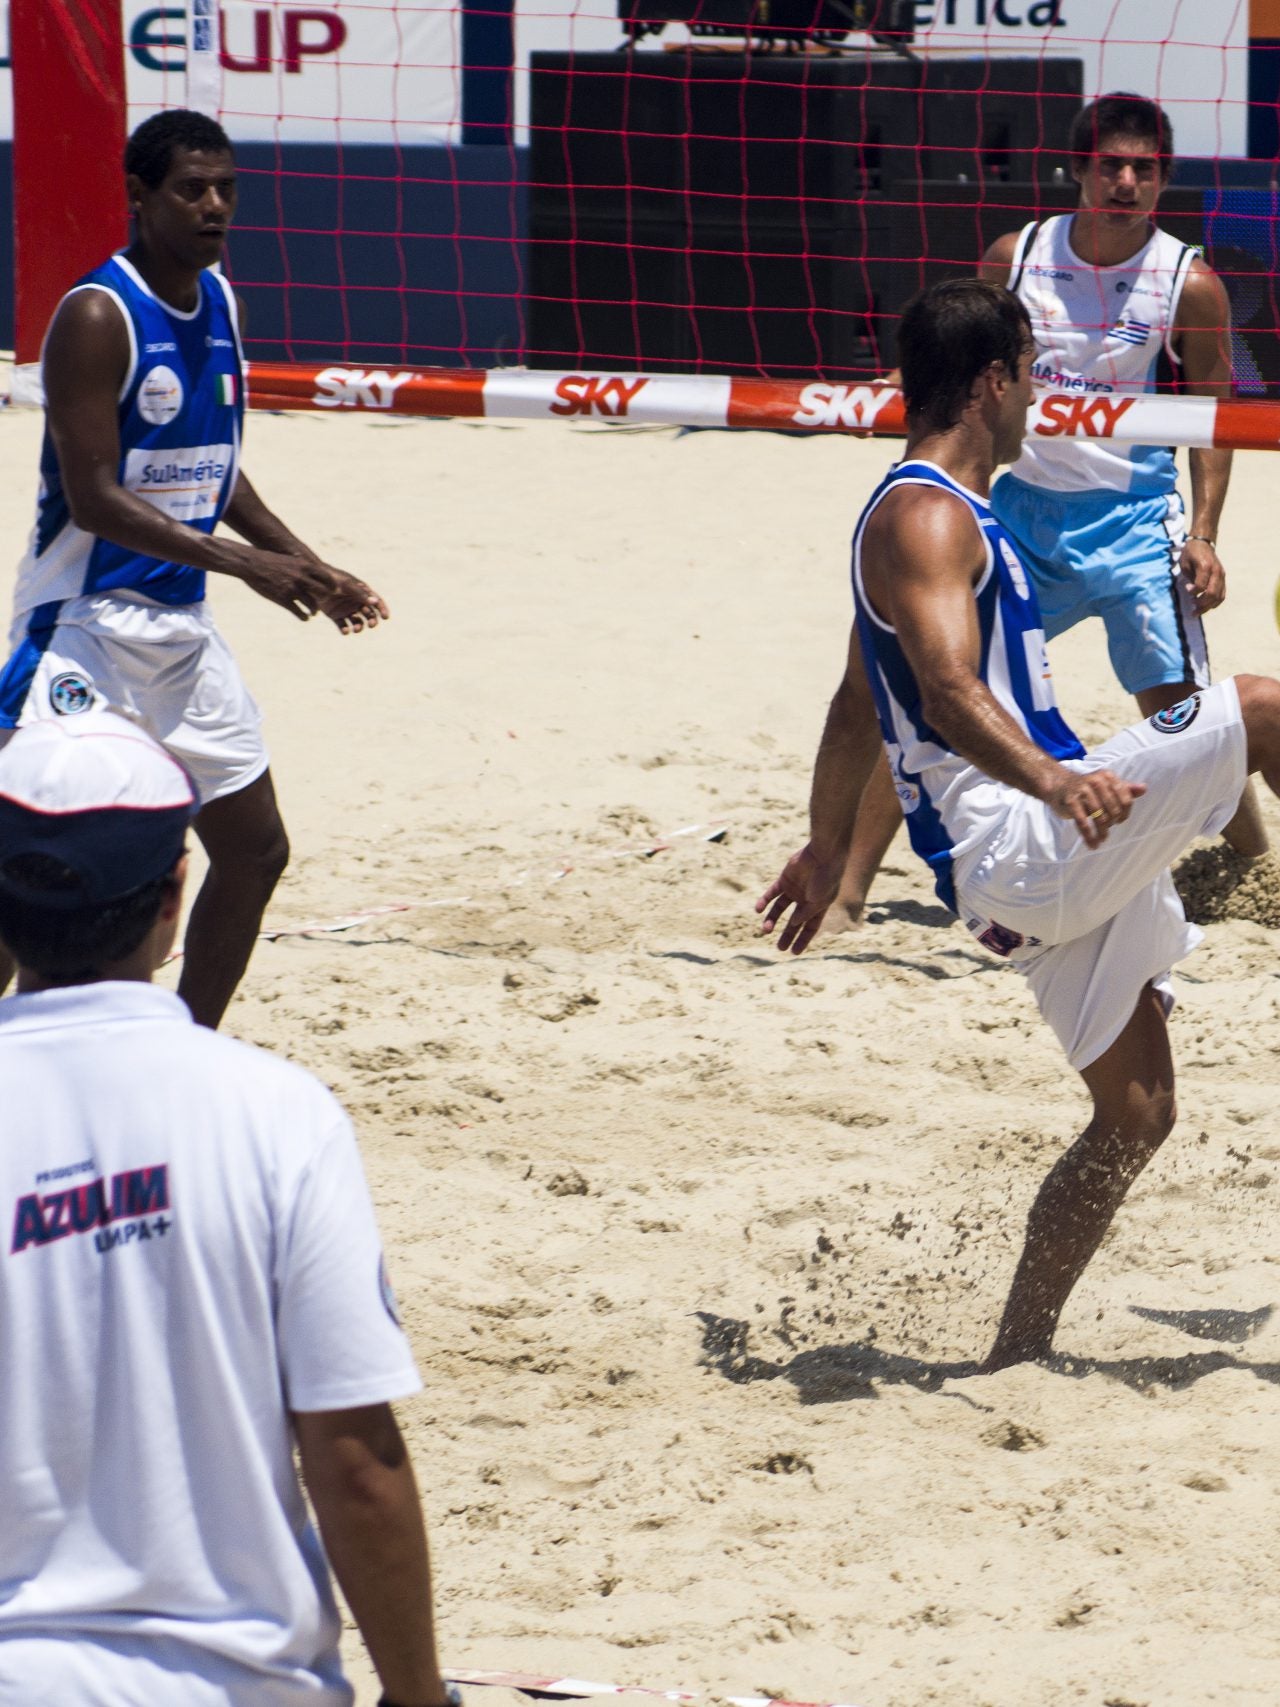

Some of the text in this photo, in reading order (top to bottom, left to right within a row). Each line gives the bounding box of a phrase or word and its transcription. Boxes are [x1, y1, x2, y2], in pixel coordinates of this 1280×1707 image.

[312, 367, 413, 408] SKY
[548, 376, 651, 417] SKY
[792, 382, 893, 427] SKY
[1033, 395, 1137, 437] SKY
[9, 1163, 170, 1255] AZULIM
